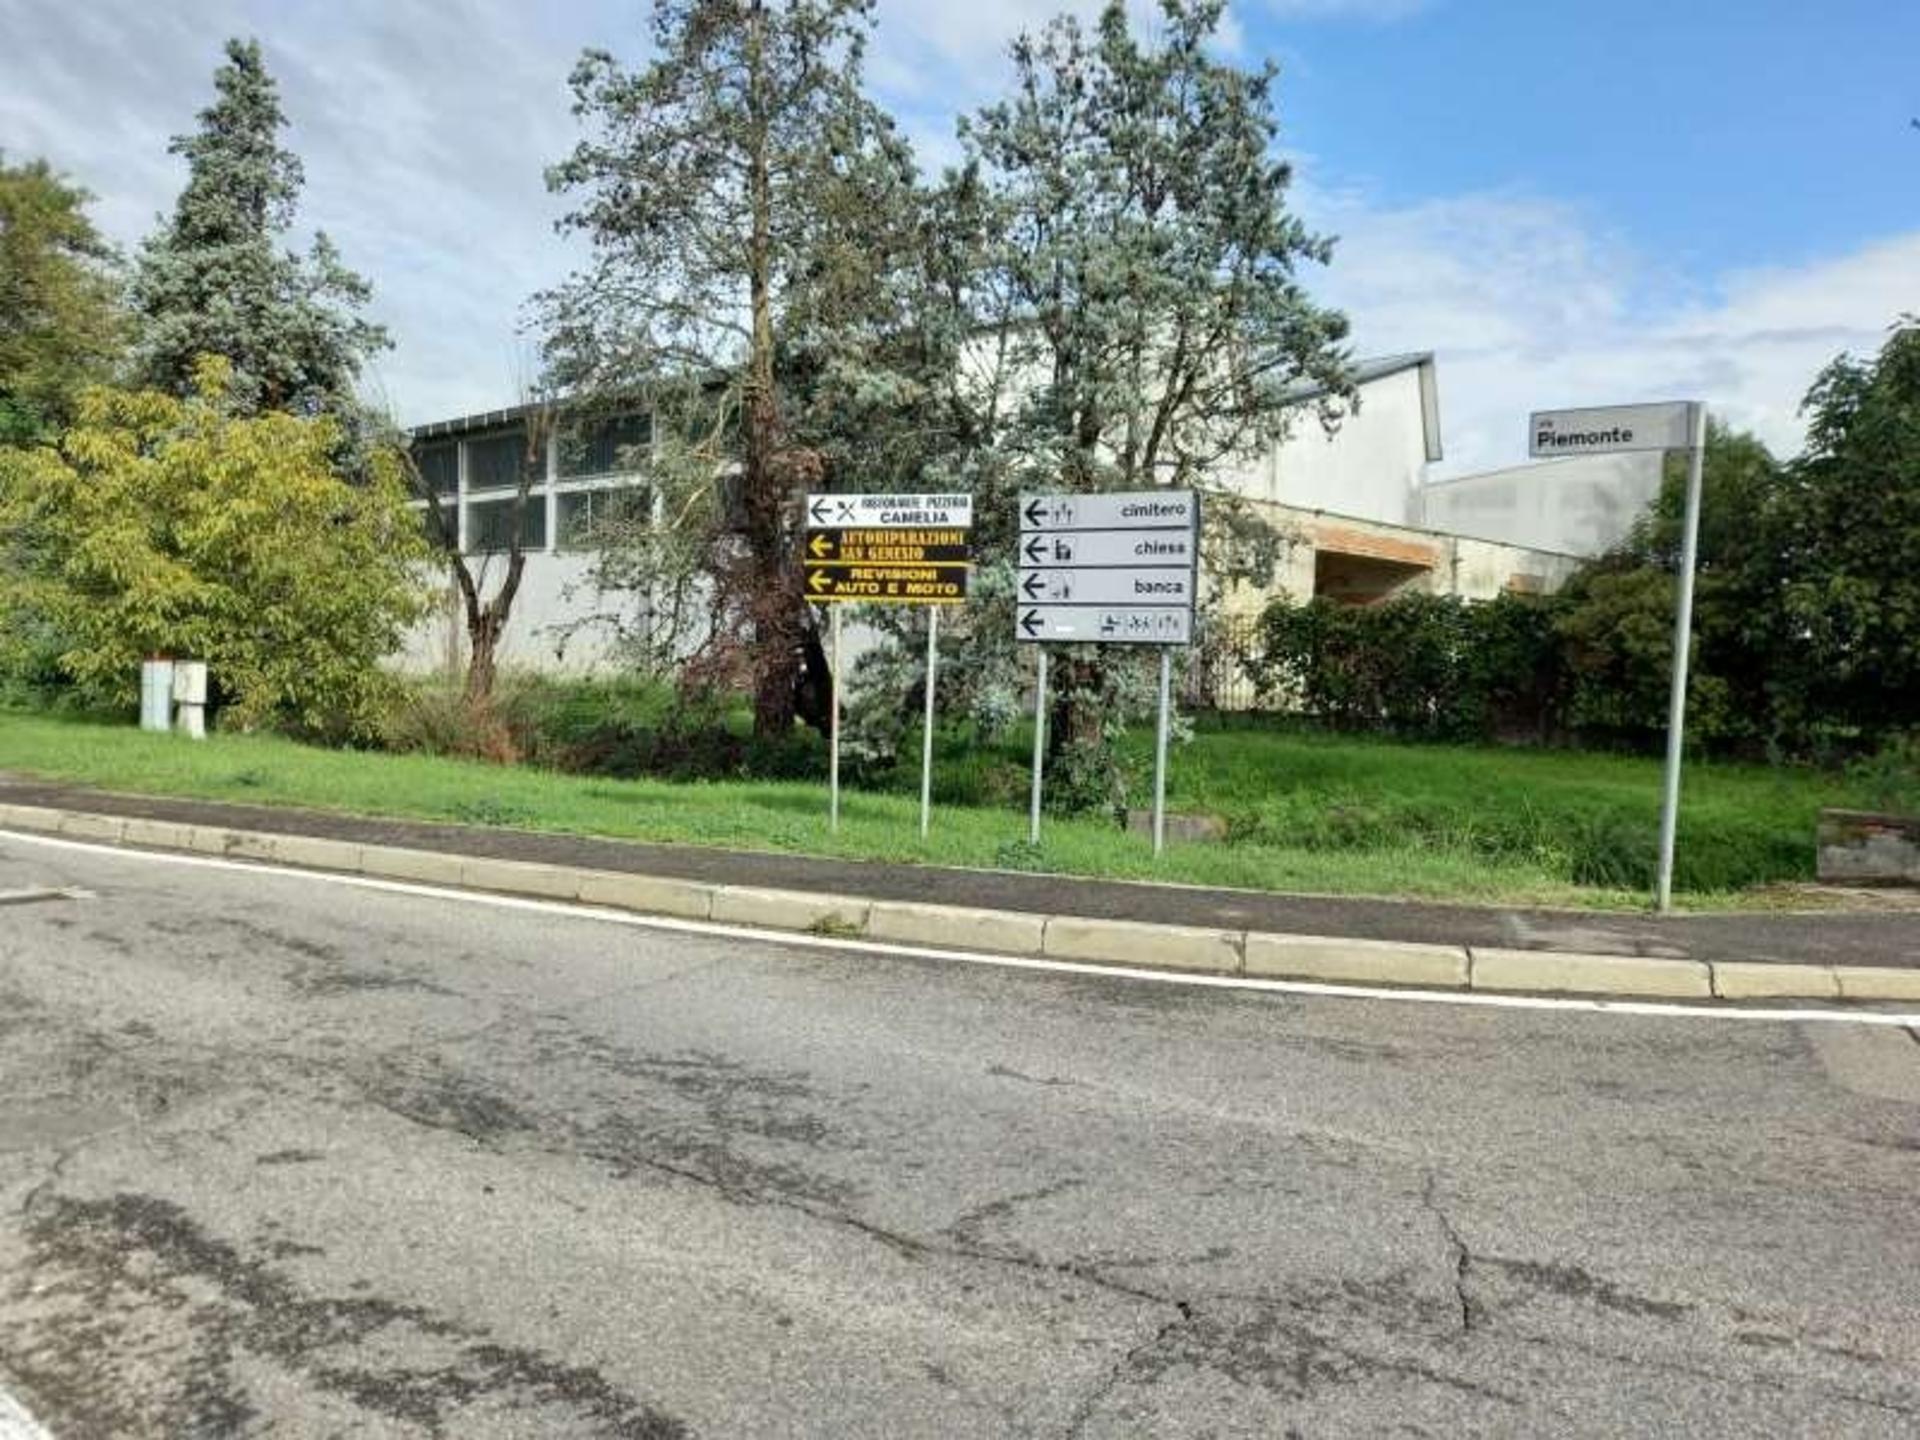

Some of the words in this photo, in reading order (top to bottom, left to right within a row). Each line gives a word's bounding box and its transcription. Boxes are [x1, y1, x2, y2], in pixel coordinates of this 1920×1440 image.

[1538, 428, 1632, 447] Piemonte
[880, 511, 949, 523] CAMELIA
[1121, 503, 1186, 517] cimitero
[841, 530, 964, 545] AUTORIPARAZIONI
[1134, 541, 1185, 555] chiesa
[850, 568, 937, 581] REVISIONI
[835, 583, 879, 594] AUTO
[887, 583, 898, 594] E
[906, 583, 959, 594] MOTO
[1134, 579, 1183, 594] banca
